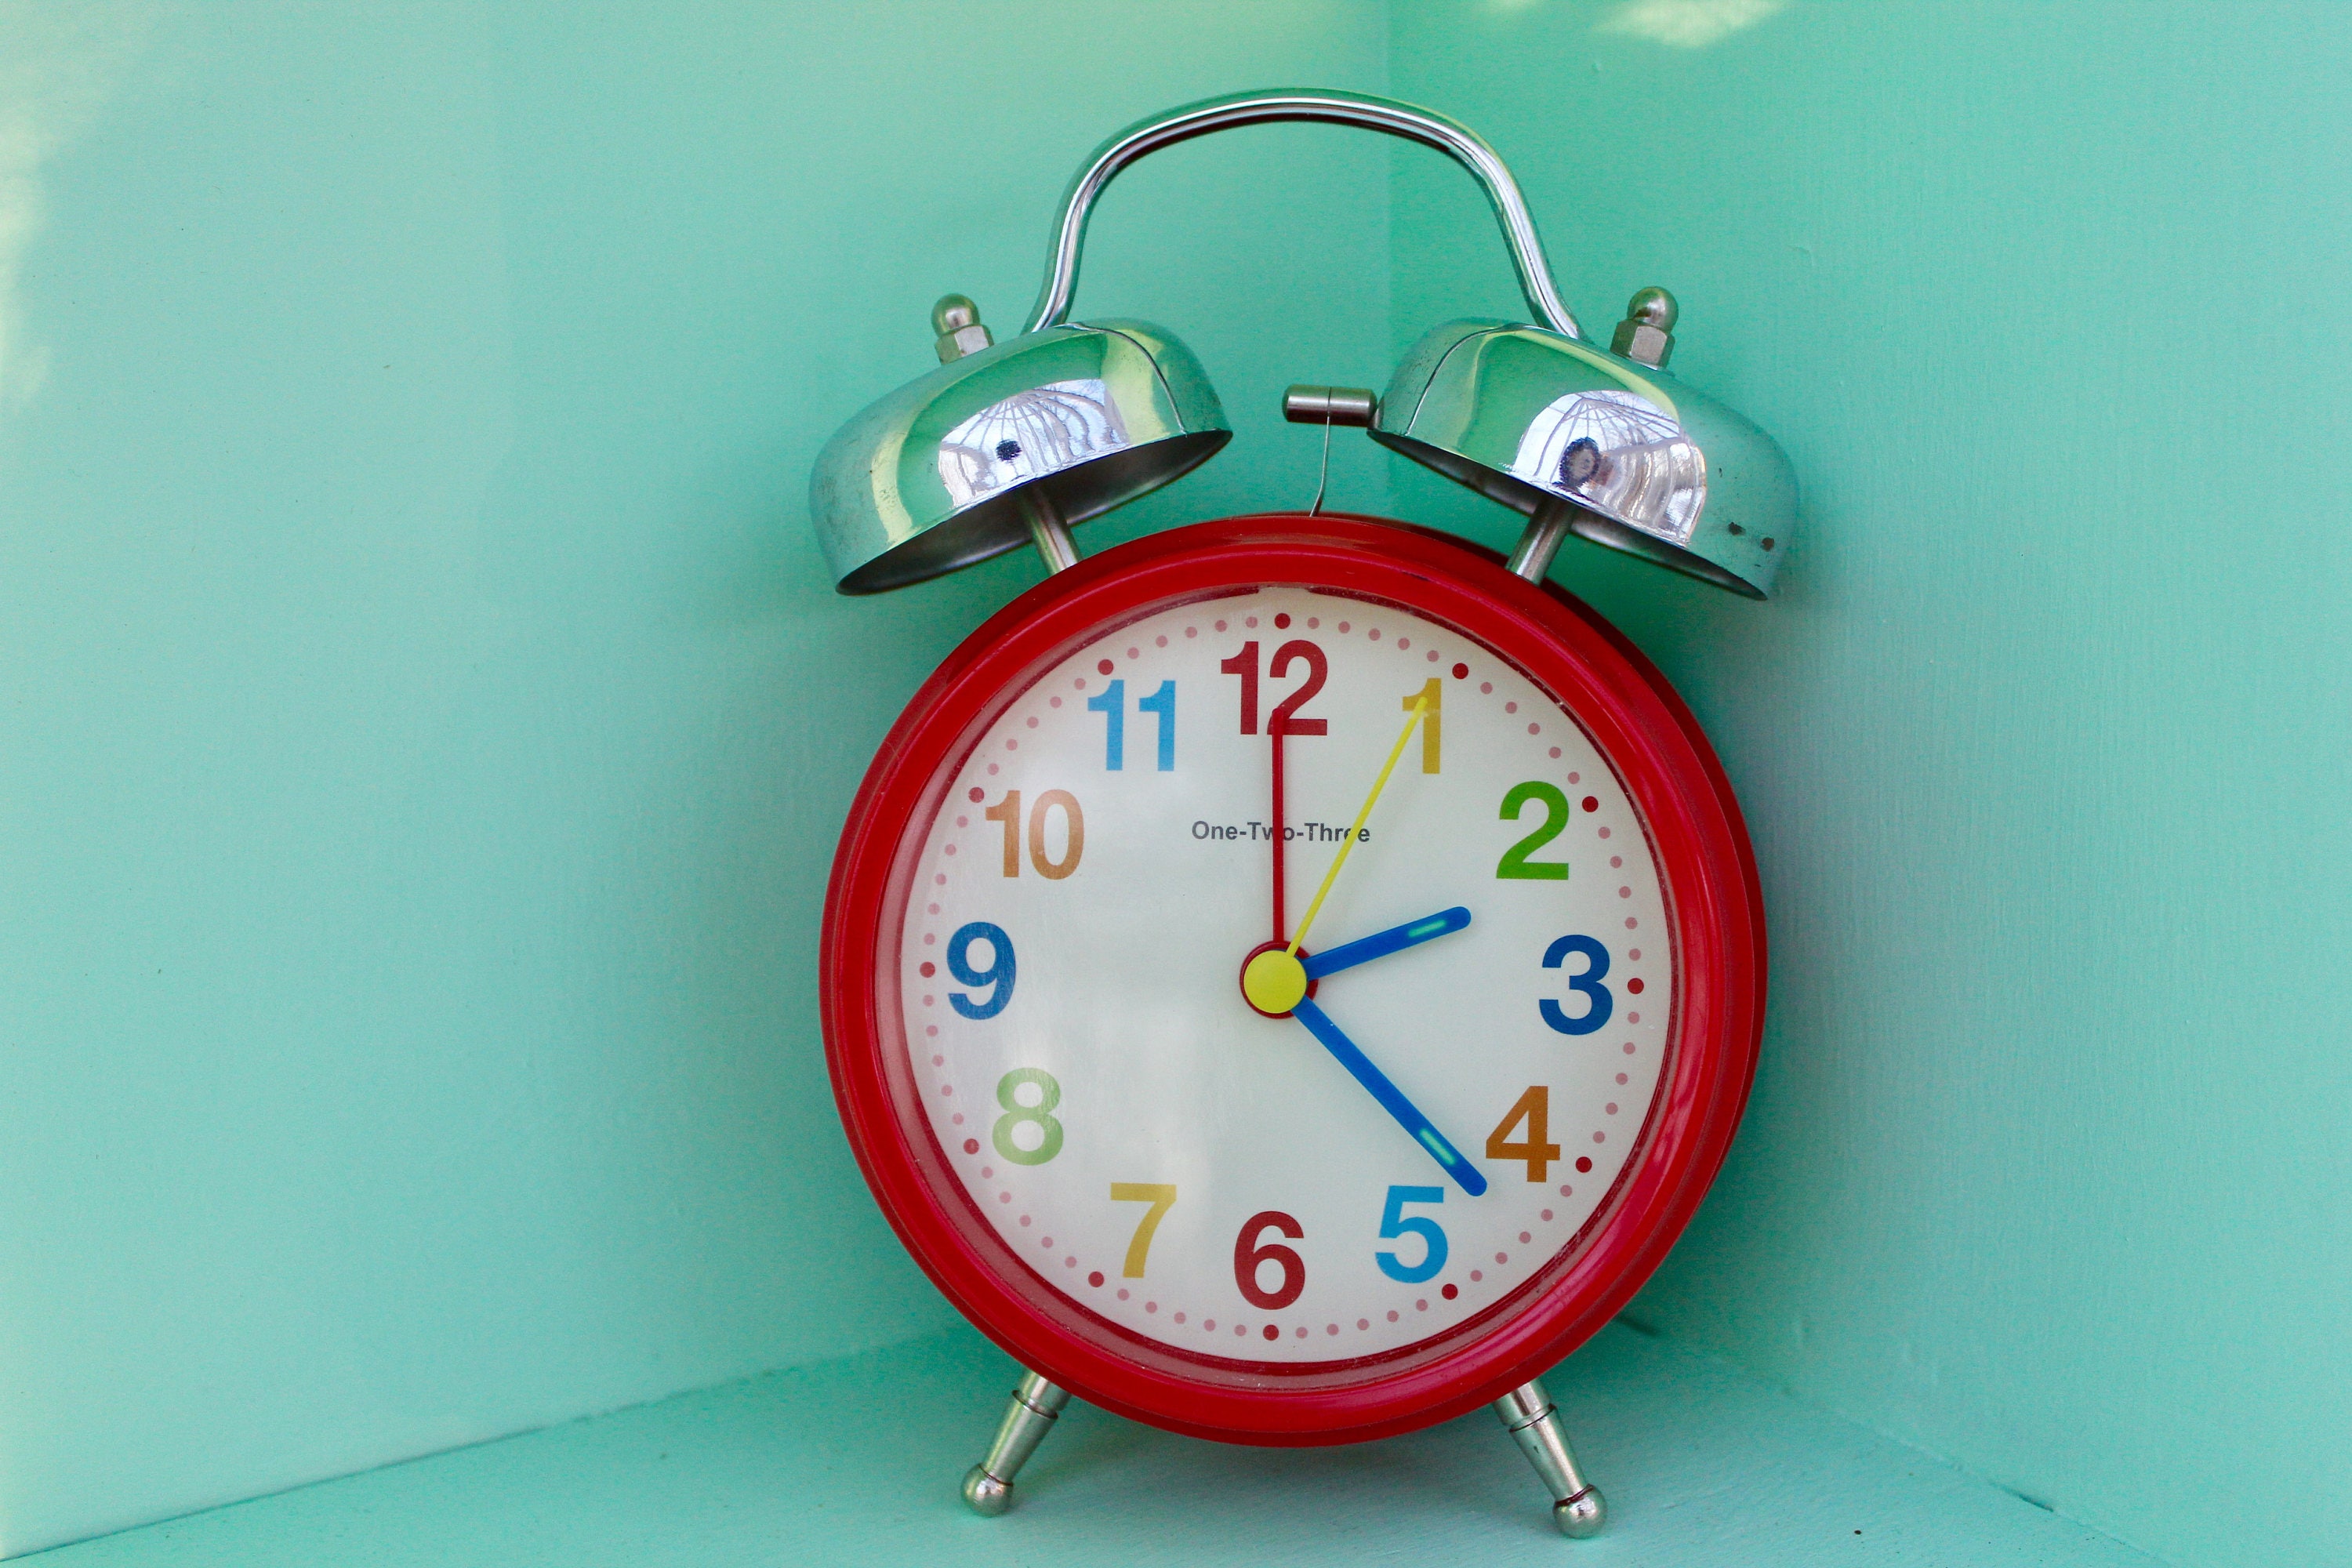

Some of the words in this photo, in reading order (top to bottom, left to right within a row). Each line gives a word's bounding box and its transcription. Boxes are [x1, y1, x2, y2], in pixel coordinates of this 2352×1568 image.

[1087, 678, 1178, 772] 11
[1220, 639, 1329, 736] 12
[1402, 677, 1443, 775] 1
[985, 789, 1085, 880] 10
[1495, 781, 1570, 881] 2
[946, 921, 1018, 1021] 9
[1538, 934, 1614, 1036] 3
[991, 1067, 1065, 1166] 8
[1484, 1085, 1562, 1184] 4
[1109, 1182, 1178, 1279] 7
[1233, 1210, 1306, 1311] 6
[1374, 1185, 1450, 1284] 5
